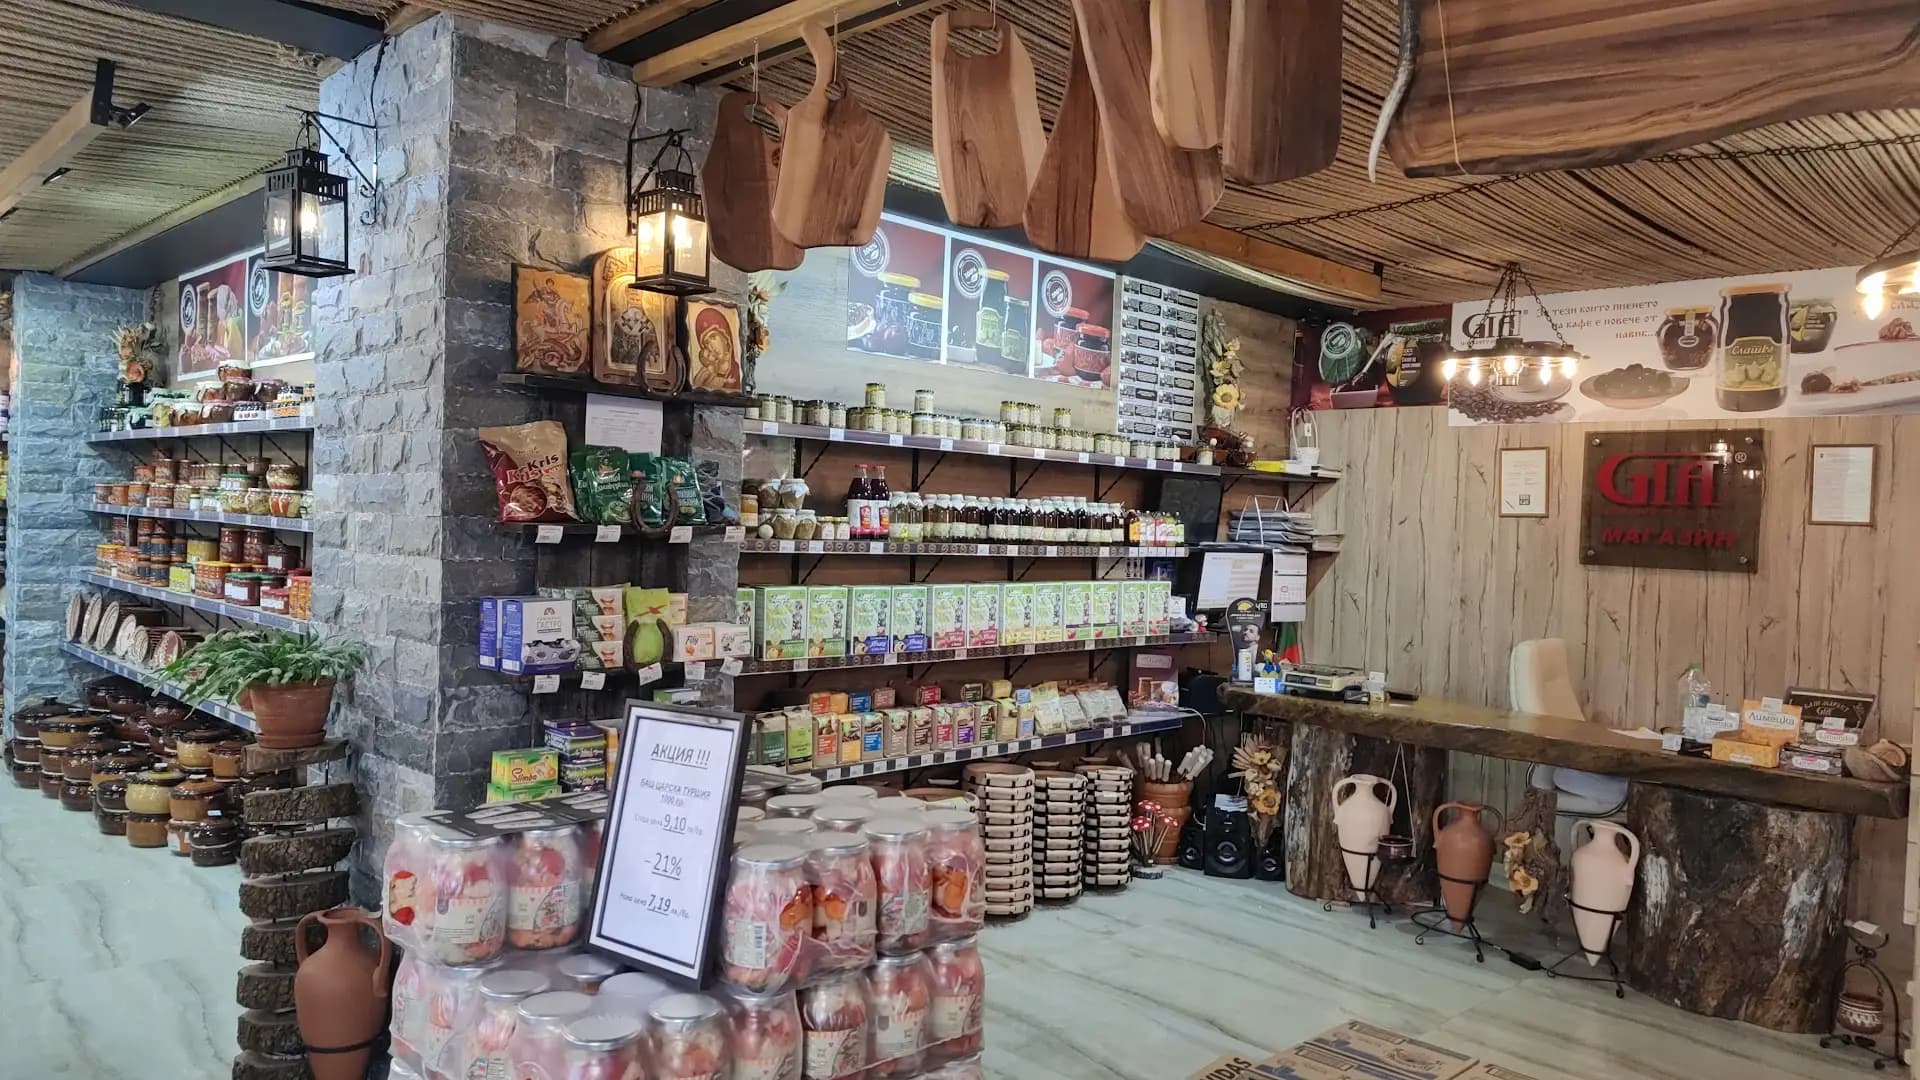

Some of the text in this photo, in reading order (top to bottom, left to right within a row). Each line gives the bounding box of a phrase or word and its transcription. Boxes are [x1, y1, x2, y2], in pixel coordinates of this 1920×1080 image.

[1596, 451, 1732, 506] GIA
[1602, 526, 1738, 549] МАГАЗИН
[651, 743, 694, 764] АКЦИЯ
[664, 814, 687, 832] 9,10
[647, 894, 672, 913] 7,19
